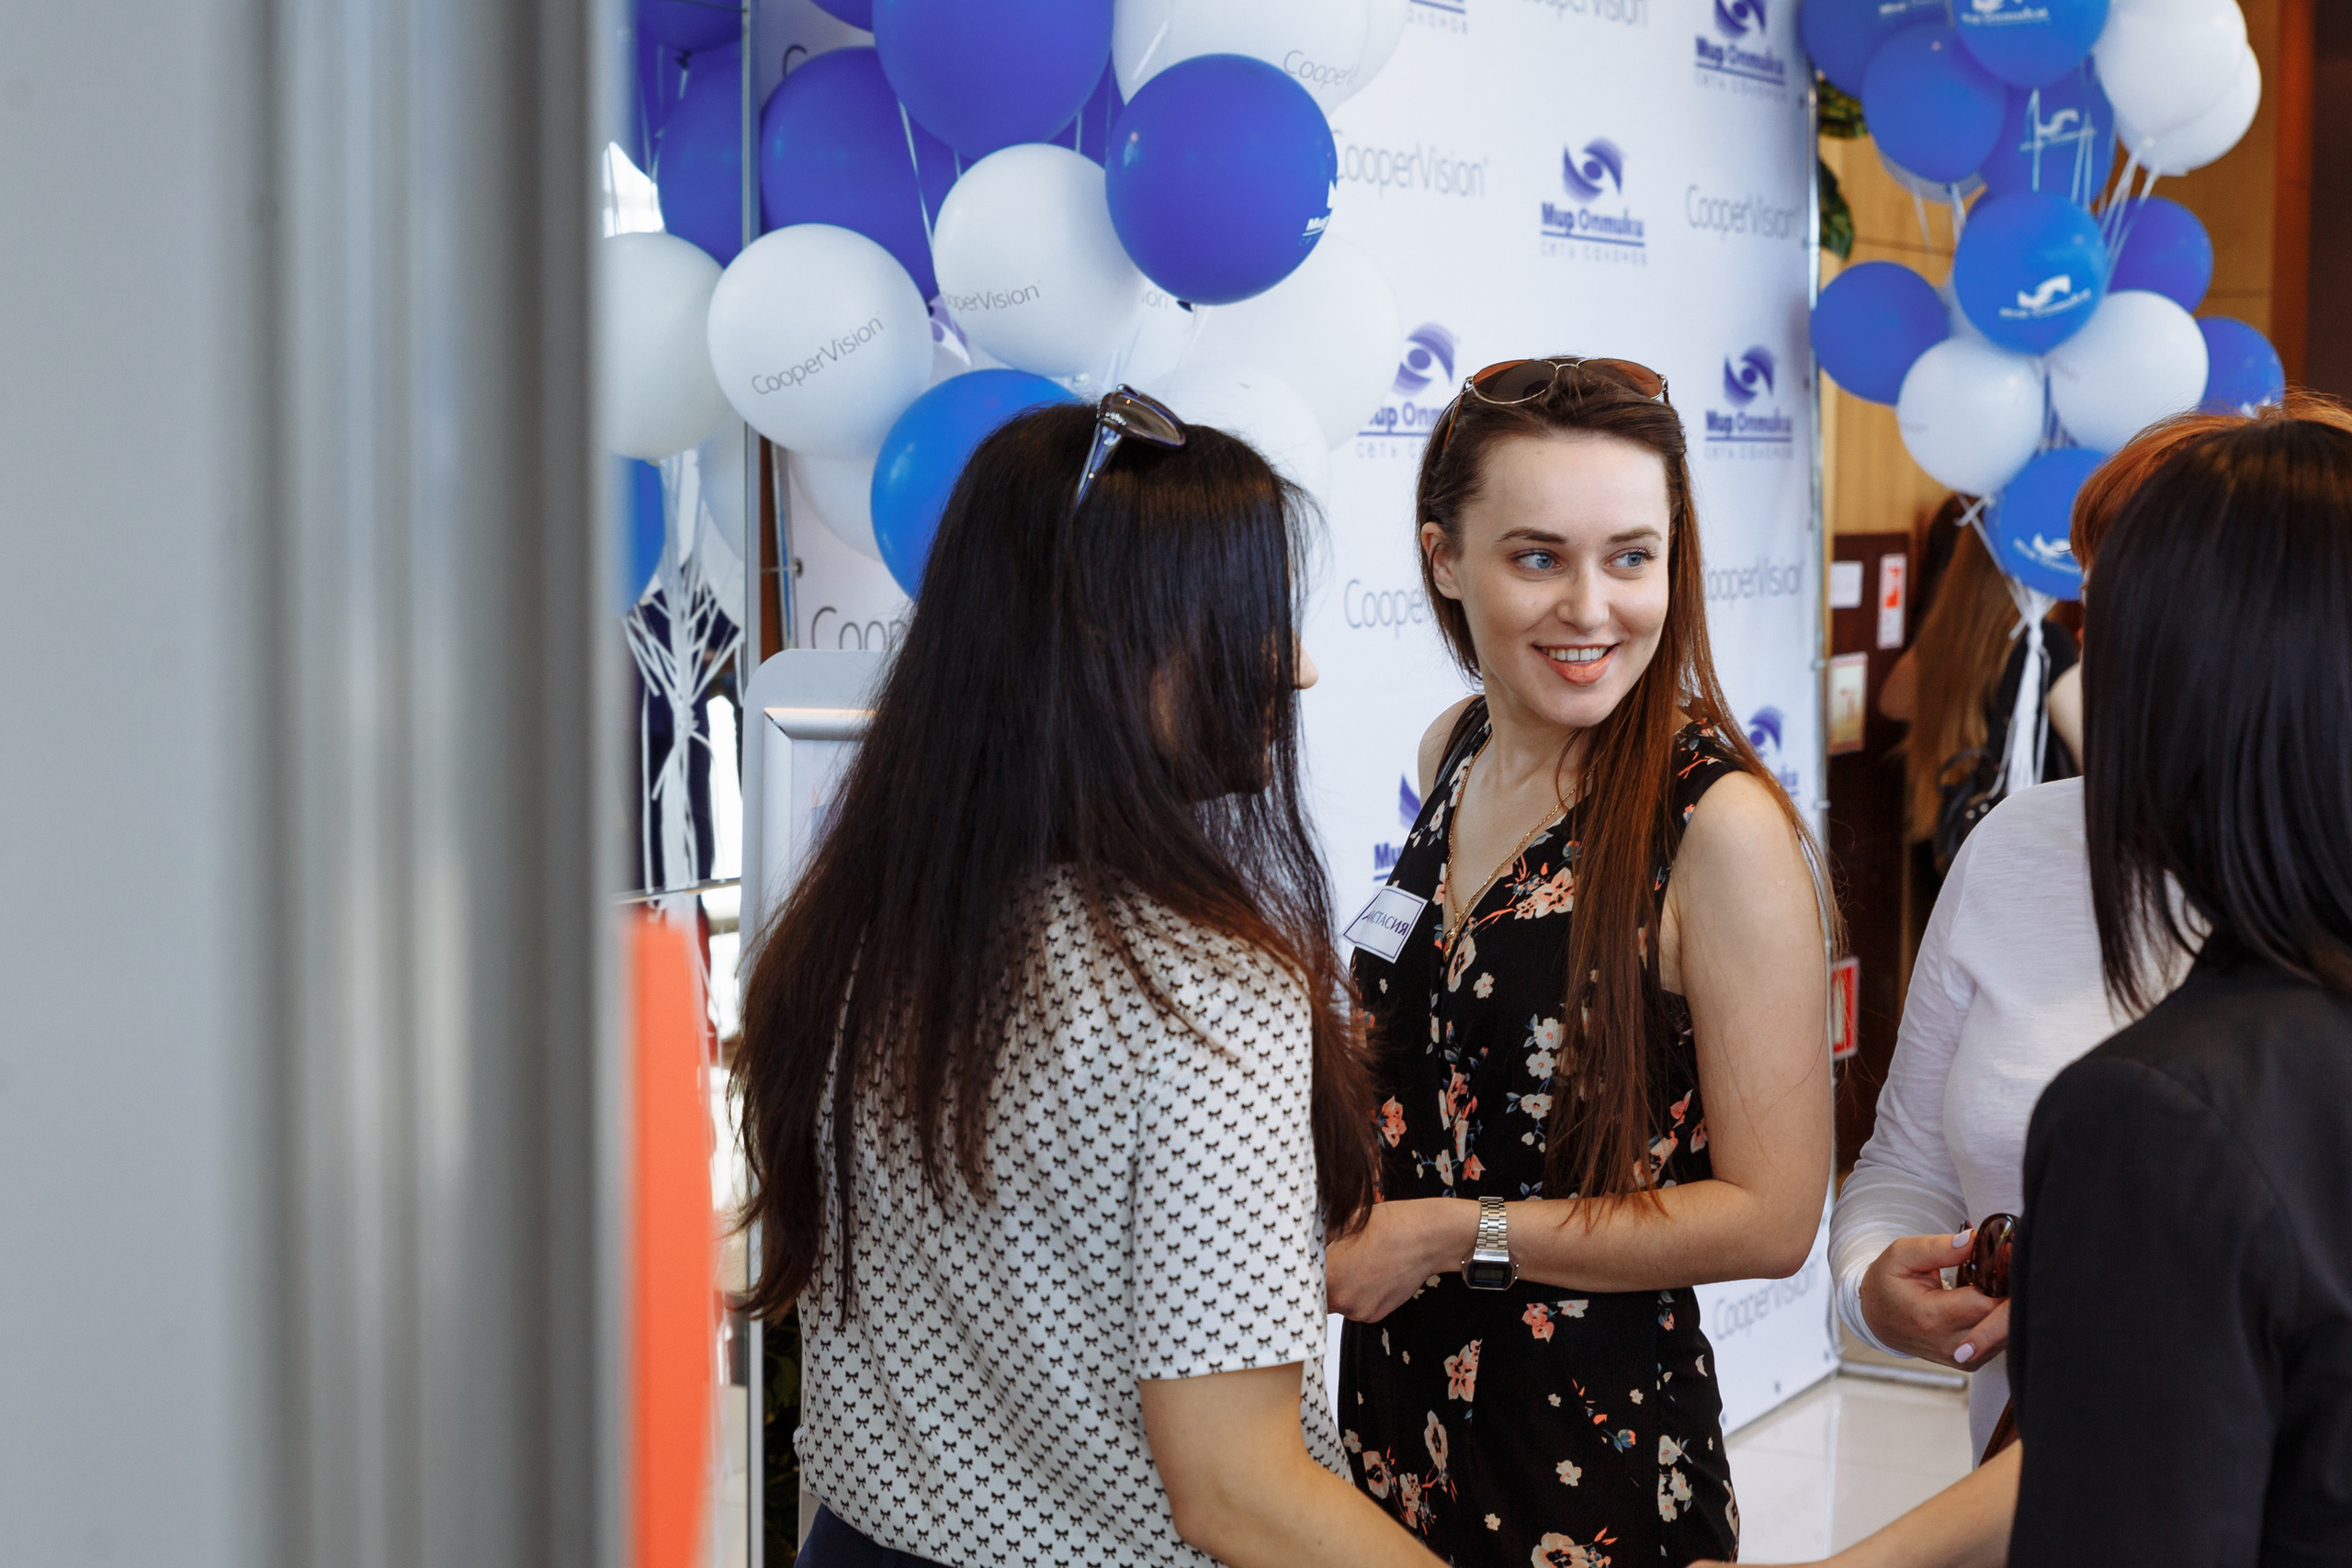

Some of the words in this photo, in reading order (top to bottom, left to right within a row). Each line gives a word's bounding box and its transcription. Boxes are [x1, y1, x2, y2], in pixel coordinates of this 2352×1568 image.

[1283, 50, 1354, 89] Cooper
[752, 317, 884, 395] CooperVision
[1344, 579, 1423, 639] Coope
